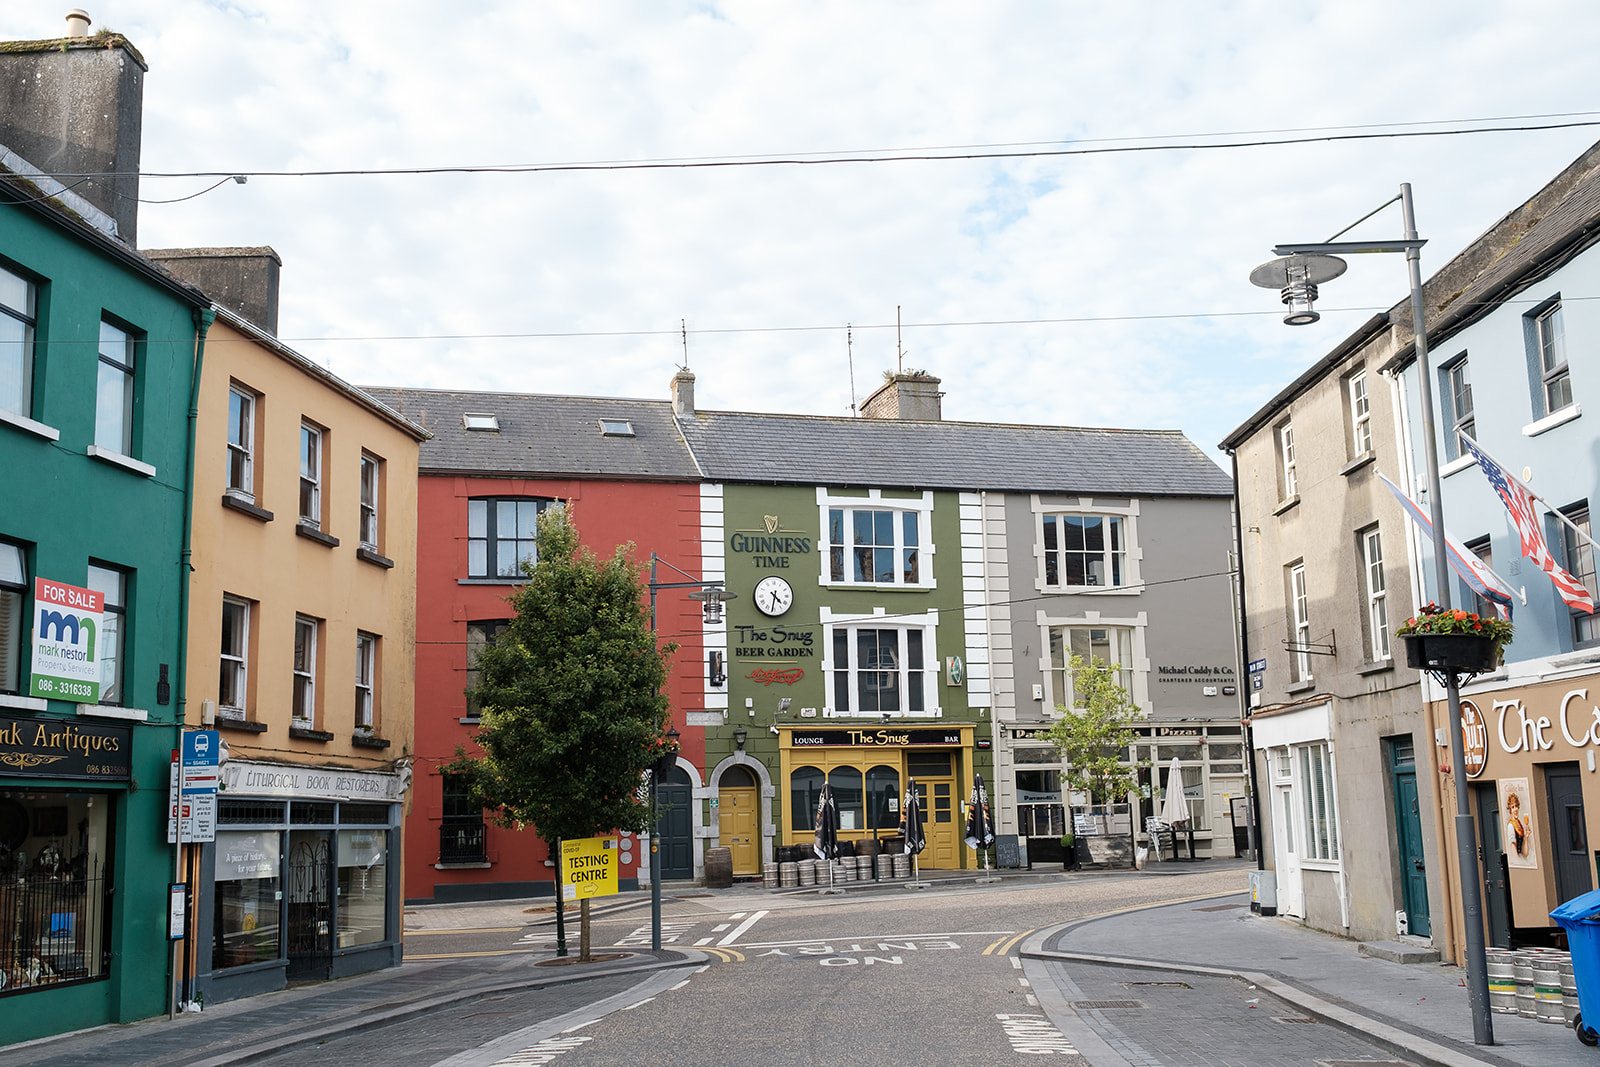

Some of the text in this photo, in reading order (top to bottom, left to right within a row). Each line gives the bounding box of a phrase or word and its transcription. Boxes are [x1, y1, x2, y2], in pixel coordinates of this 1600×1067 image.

[731, 533, 811, 554] GUINNESS
[753, 556, 790, 568] TIME
[43, 585, 96, 609] FOR SALE
[734, 625, 814, 646] The Snug
[39, 644, 86, 661] mark nestor
[735, 648, 814, 657] BEER GARDEN
[38, 657, 95, 676] Property Services
[1158, 666, 1187, 674] Michael
[1188, 666, 1212, 676] Cuddy
[1221, 666, 1234, 674] Co.
[38, 679, 53, 691] 086
[60, 682, 92, 696] 3316338
[1160, 727, 1197, 736] Pizzas
[1492, 699, 1553, 753] The
[33, 723, 119, 757] Antiques
[847, 731, 874, 745] The
[875, 730, 910, 746] Snug
[86, 764, 99, 774] 086
[246, 770, 300, 789] LITURGICAL
[306, 776, 331, 790] BOOK
[569, 854, 609, 868] TESTING
[571, 869, 608, 883] CENTRE
[756, 941, 961, 957] ENTRY
[819, 956, 903, 967] NO
